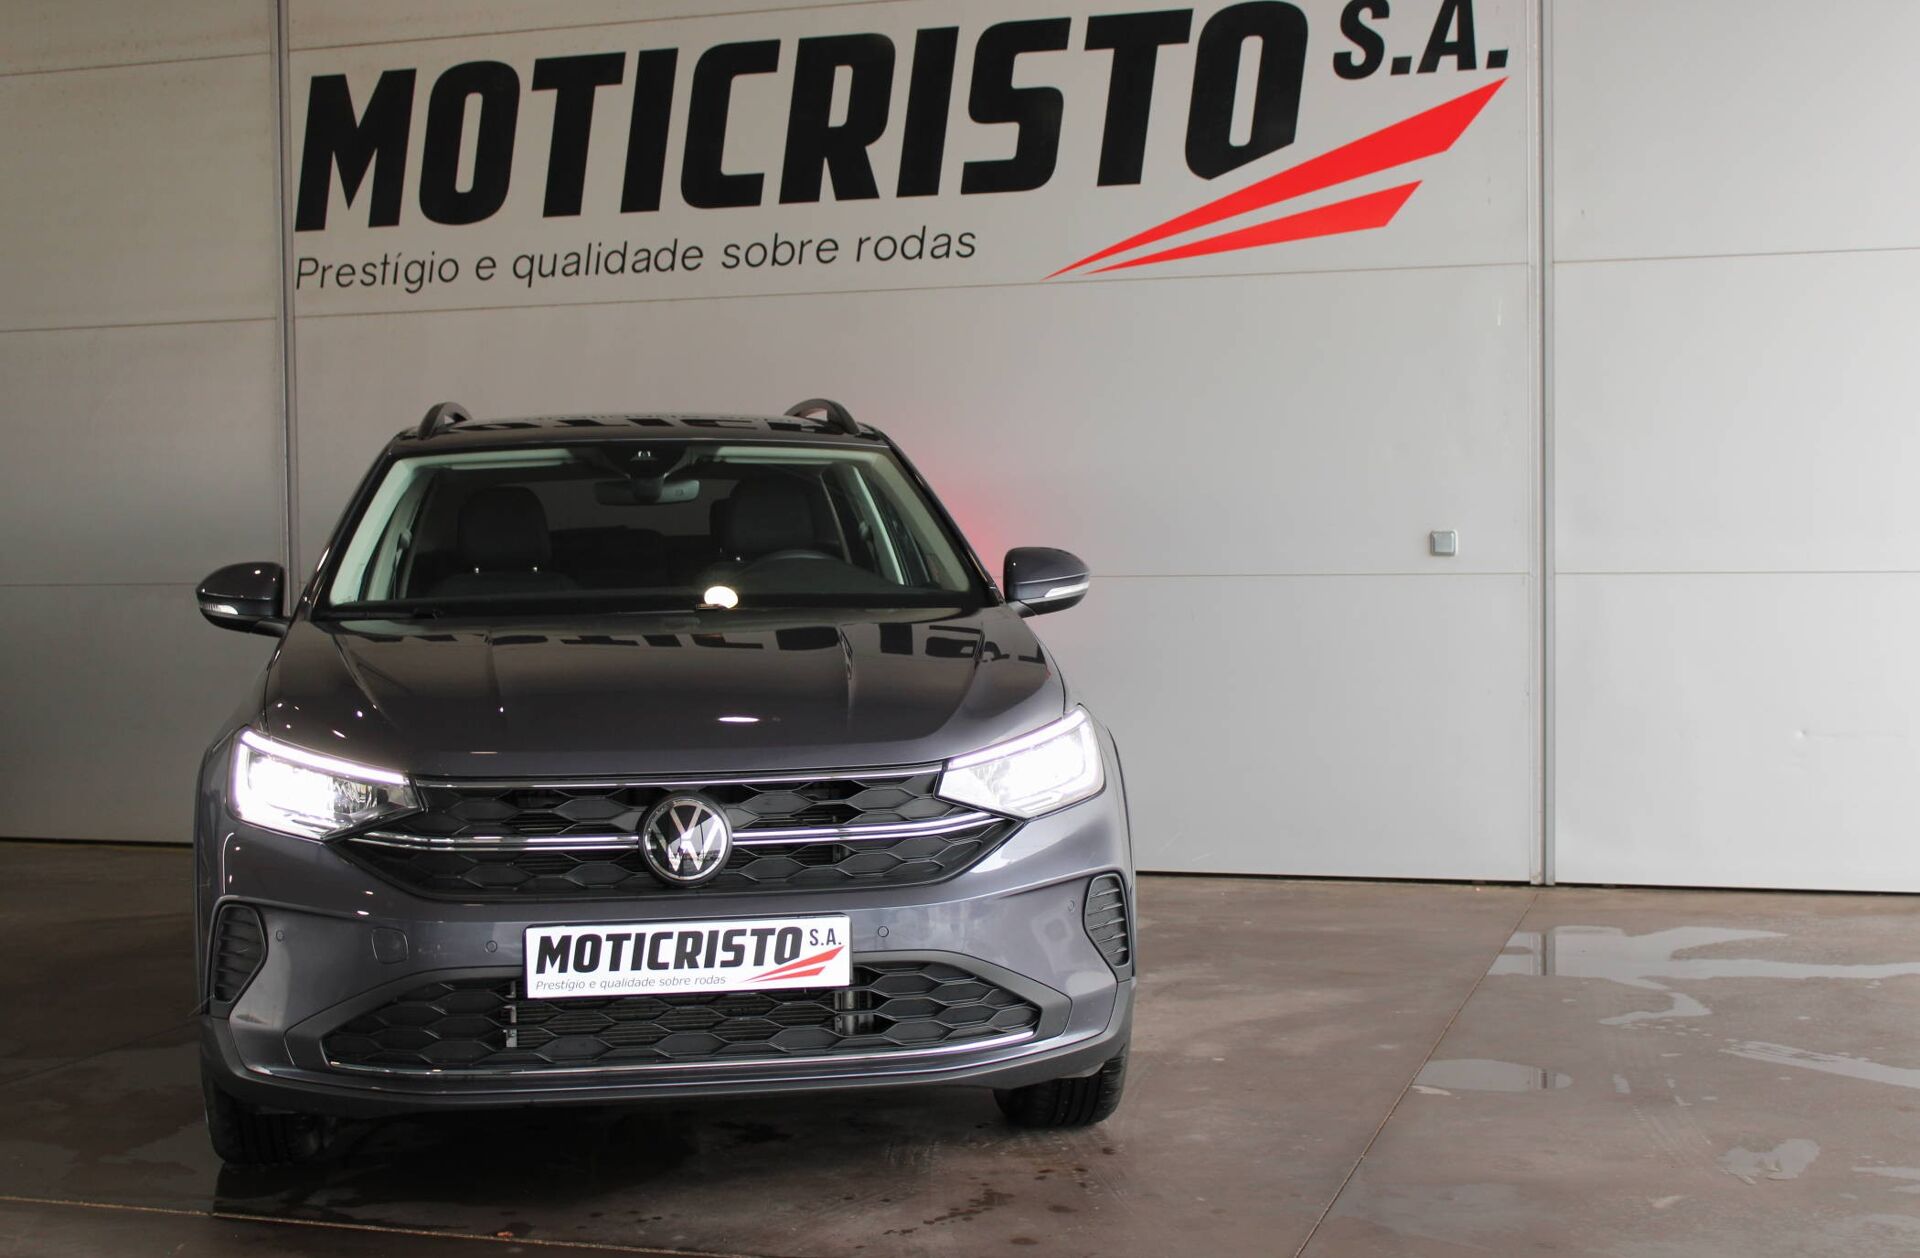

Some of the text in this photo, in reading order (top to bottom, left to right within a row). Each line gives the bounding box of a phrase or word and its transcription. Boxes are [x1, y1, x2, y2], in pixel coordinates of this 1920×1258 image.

[295, 0, 1508, 232] MOTICRISTO S.A.
[296, 224, 977, 294] Prestígio e qualidade sobre rodas
[535, 926, 842, 975] MOTICRISTO S.A.
[535, 974, 726, 992] Prestígio e qualidade sobre rodas
